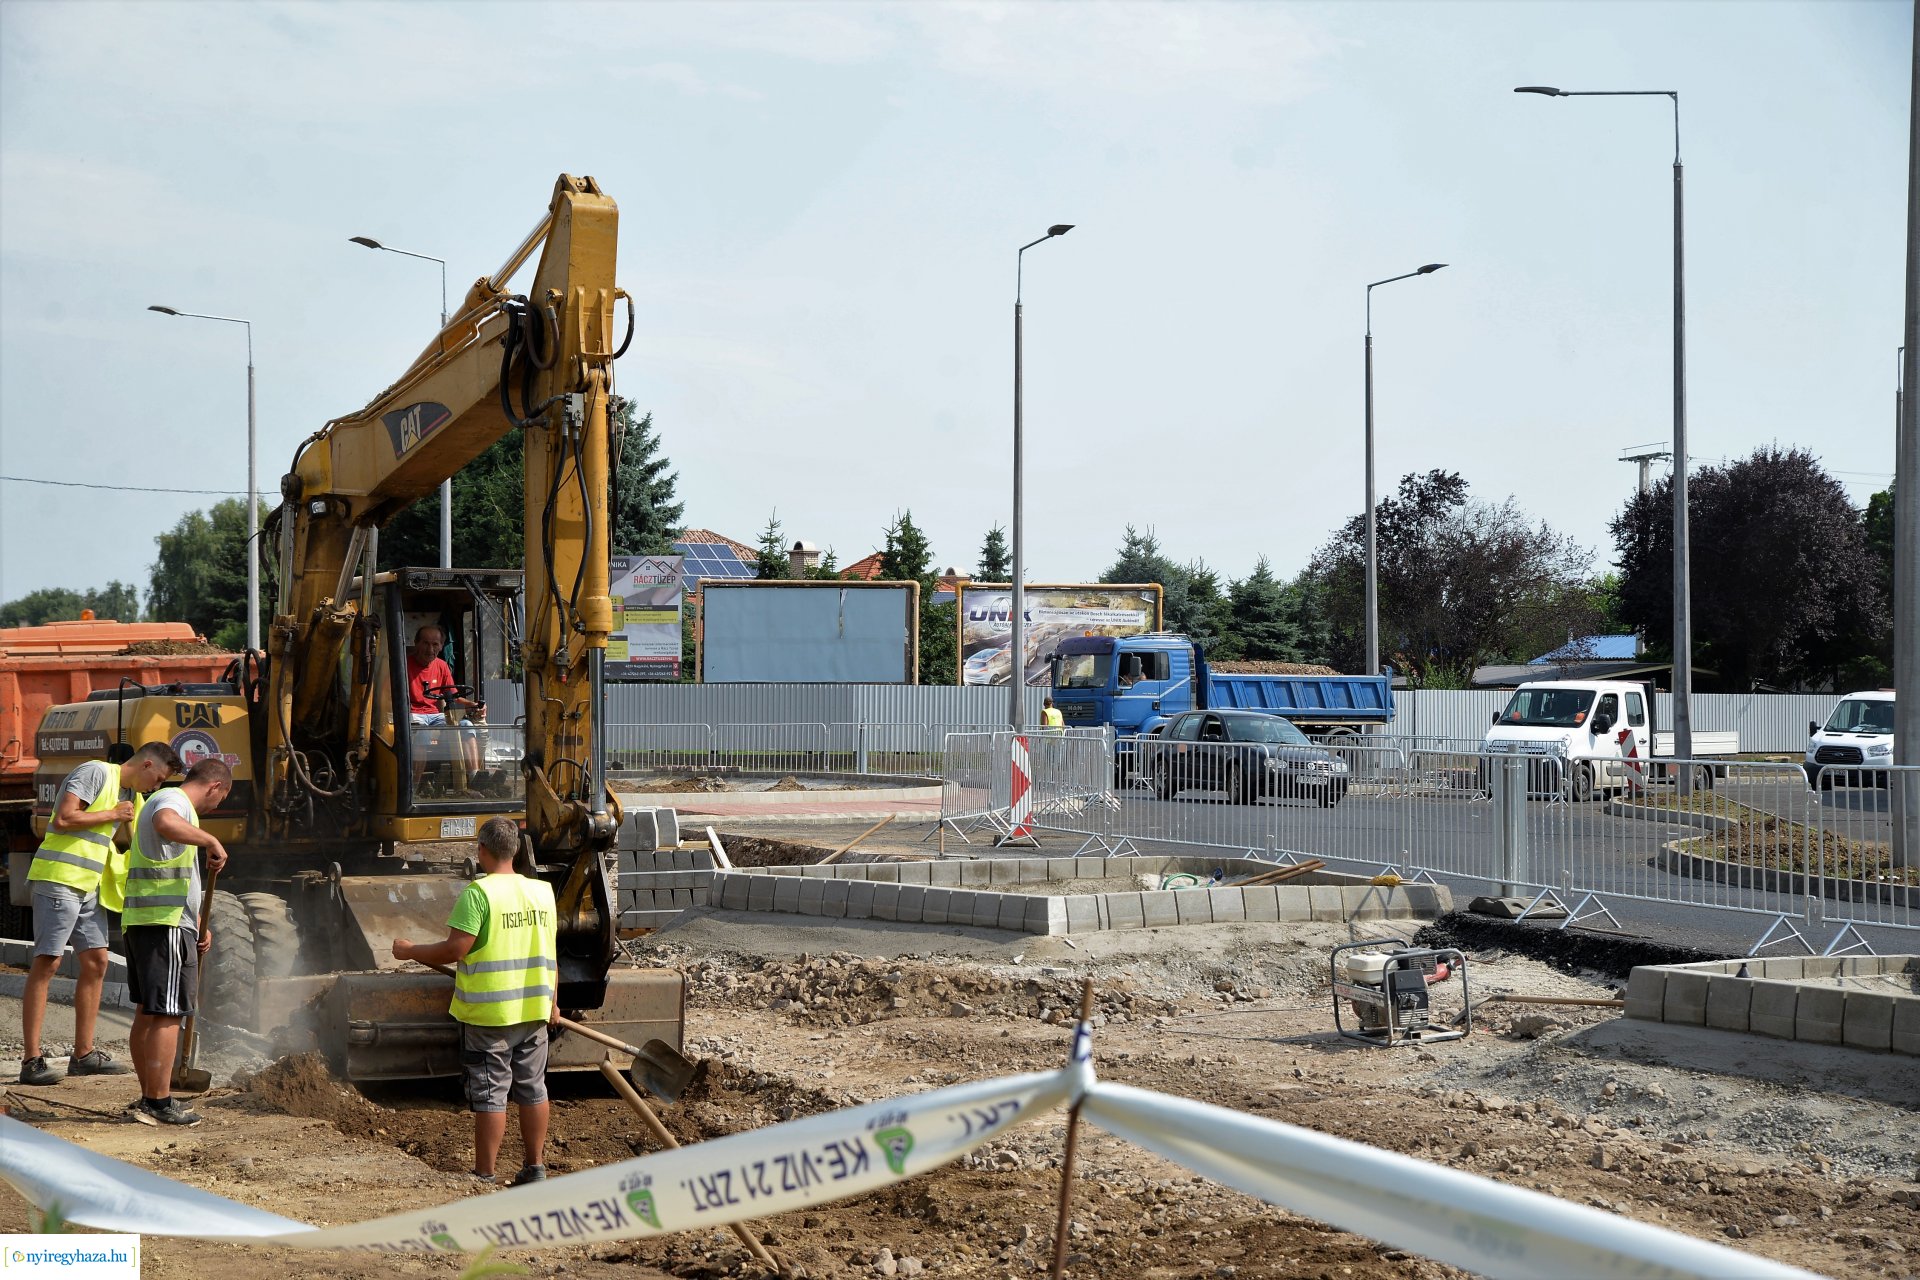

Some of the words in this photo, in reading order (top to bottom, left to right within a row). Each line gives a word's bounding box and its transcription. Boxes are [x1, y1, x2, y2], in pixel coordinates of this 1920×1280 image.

[400, 404, 422, 453] CAT
[633, 574, 676, 584] RÁCZTÜZÉP
[175, 702, 222, 728] CAT
[38, 784, 56, 802] M318
[502, 907, 537, 929] TISZA-ÚT
[680, 1171, 739, 1213] ZRT.
[741, 1162, 773, 1200] 21
[521, 1214, 554, 1243] 21
